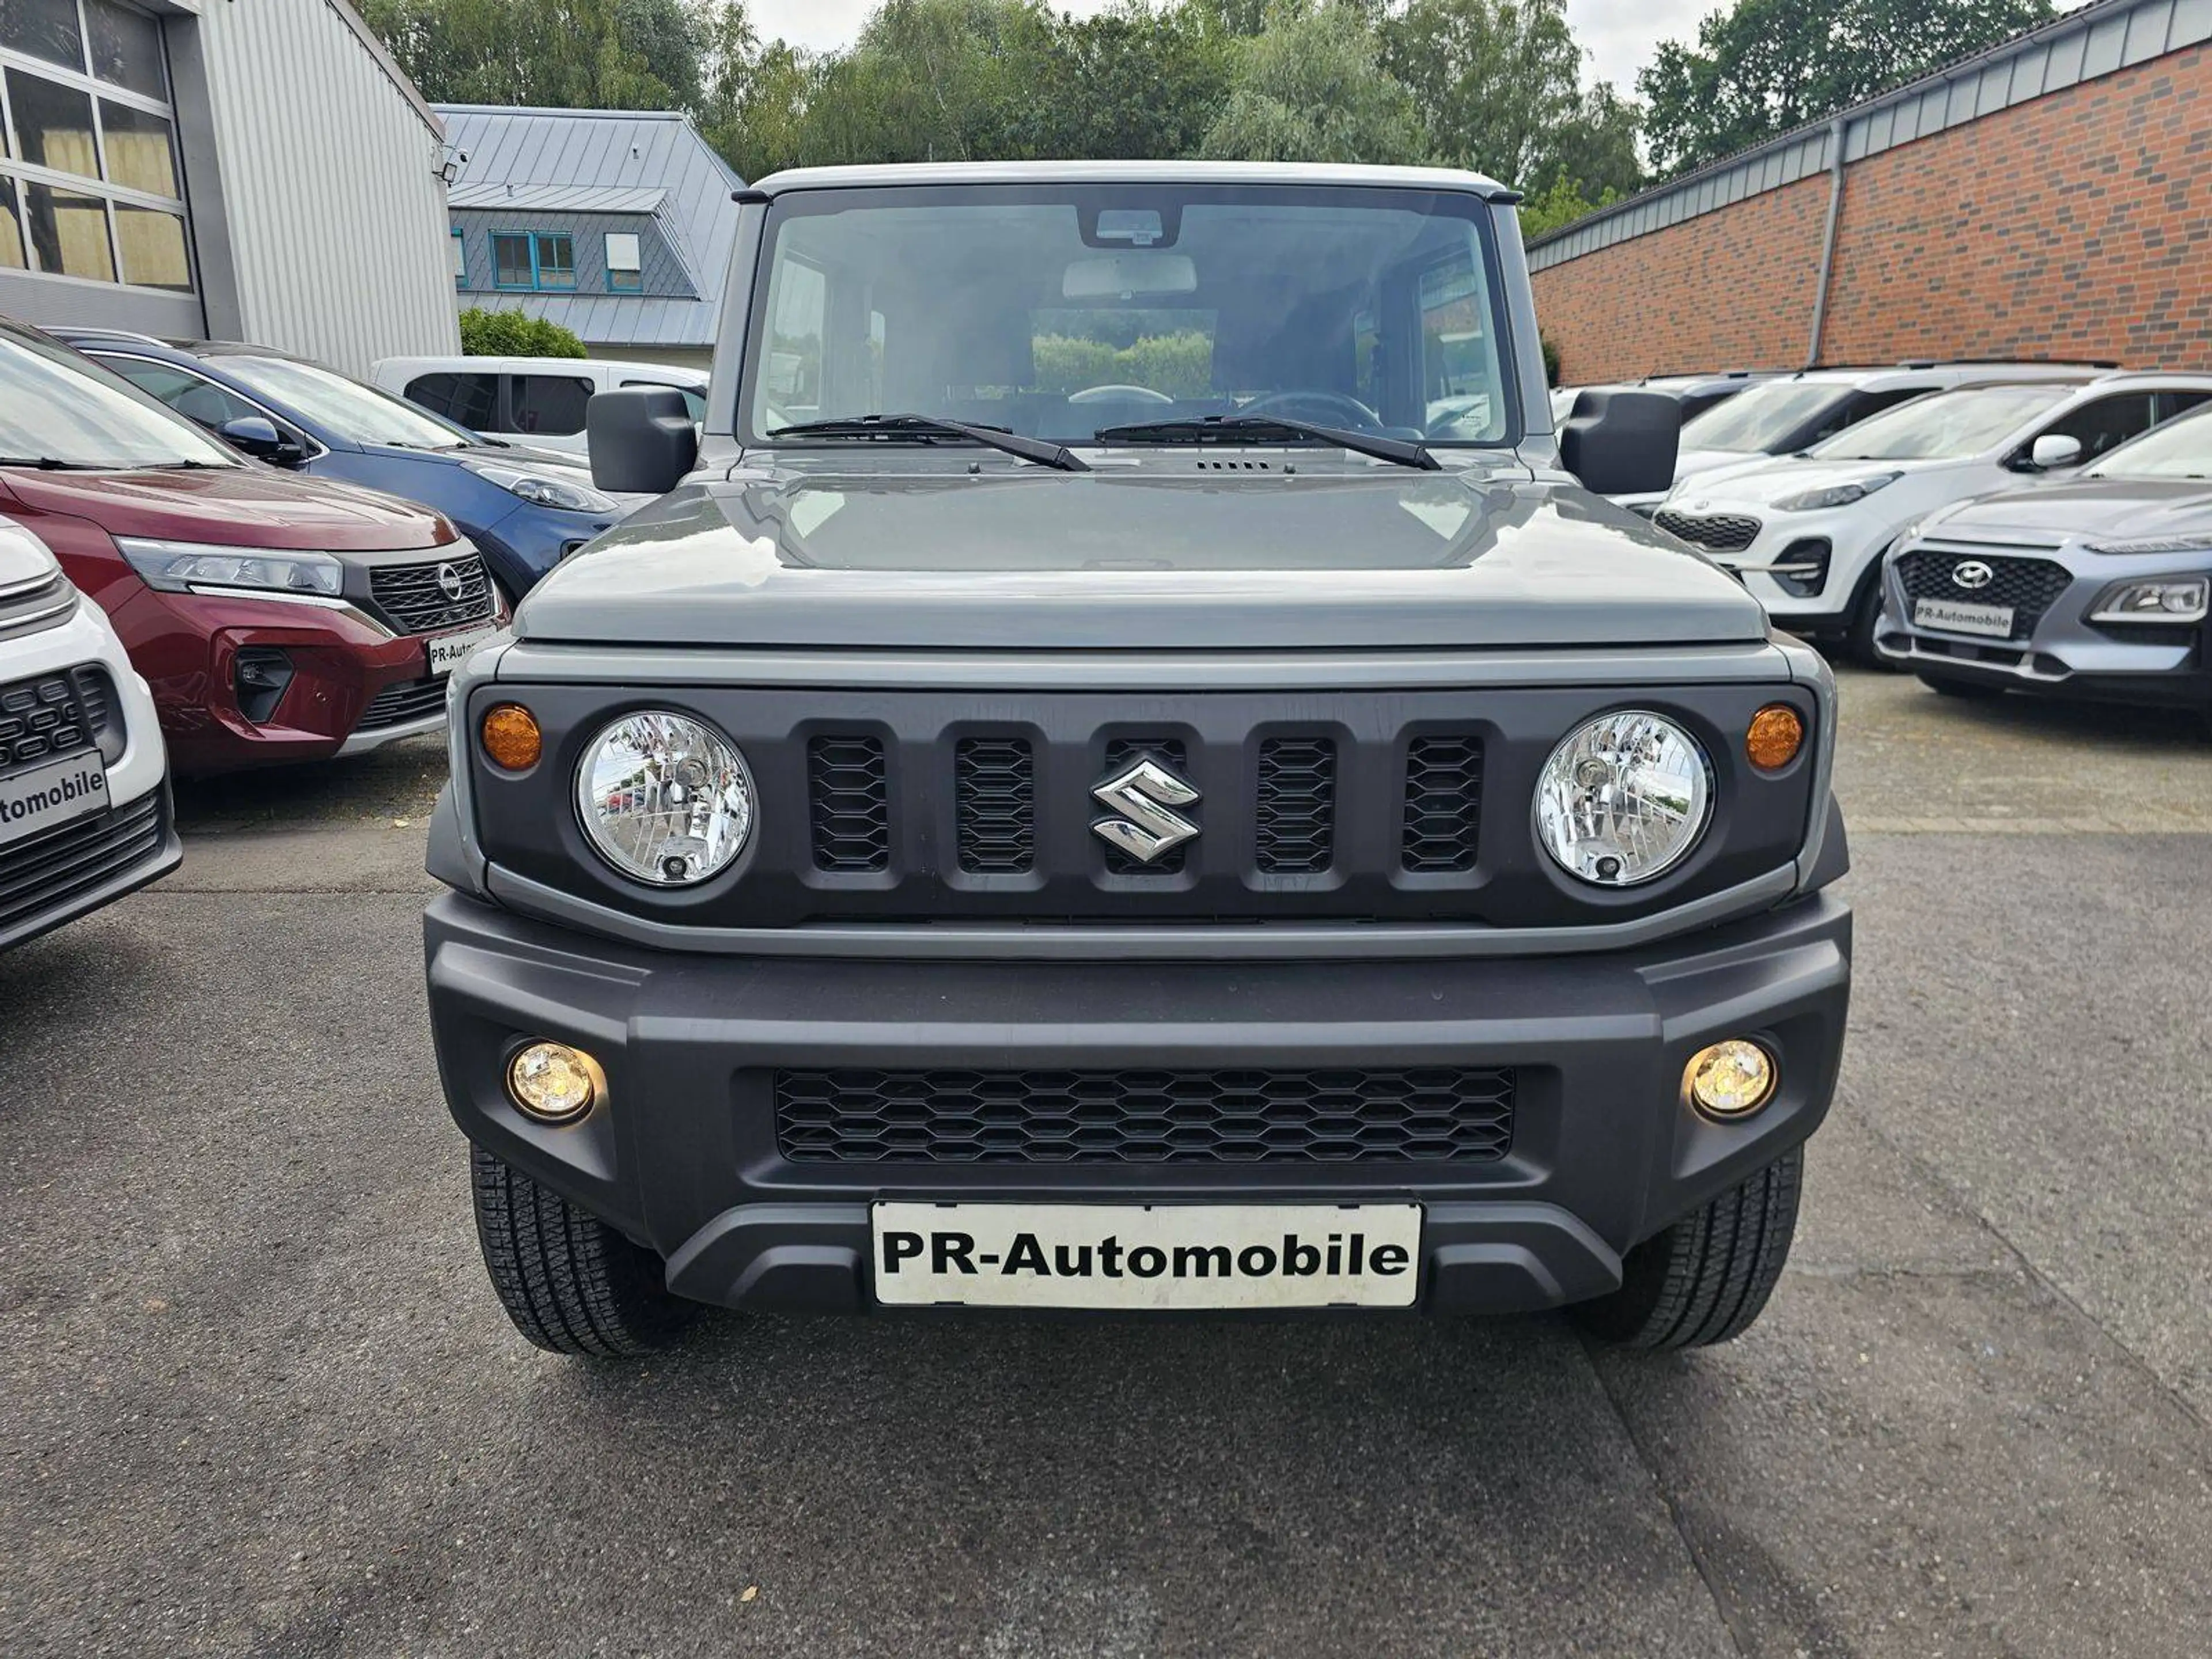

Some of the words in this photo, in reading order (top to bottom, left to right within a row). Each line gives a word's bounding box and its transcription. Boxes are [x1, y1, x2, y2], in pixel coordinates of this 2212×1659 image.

[1916, 607, 2009, 628] PR-Automobile
[431, 643, 476, 664] PR-Aut
[0, 771, 103, 823] tomobile
[883, 1232, 1409, 1277] PR-Automobile
